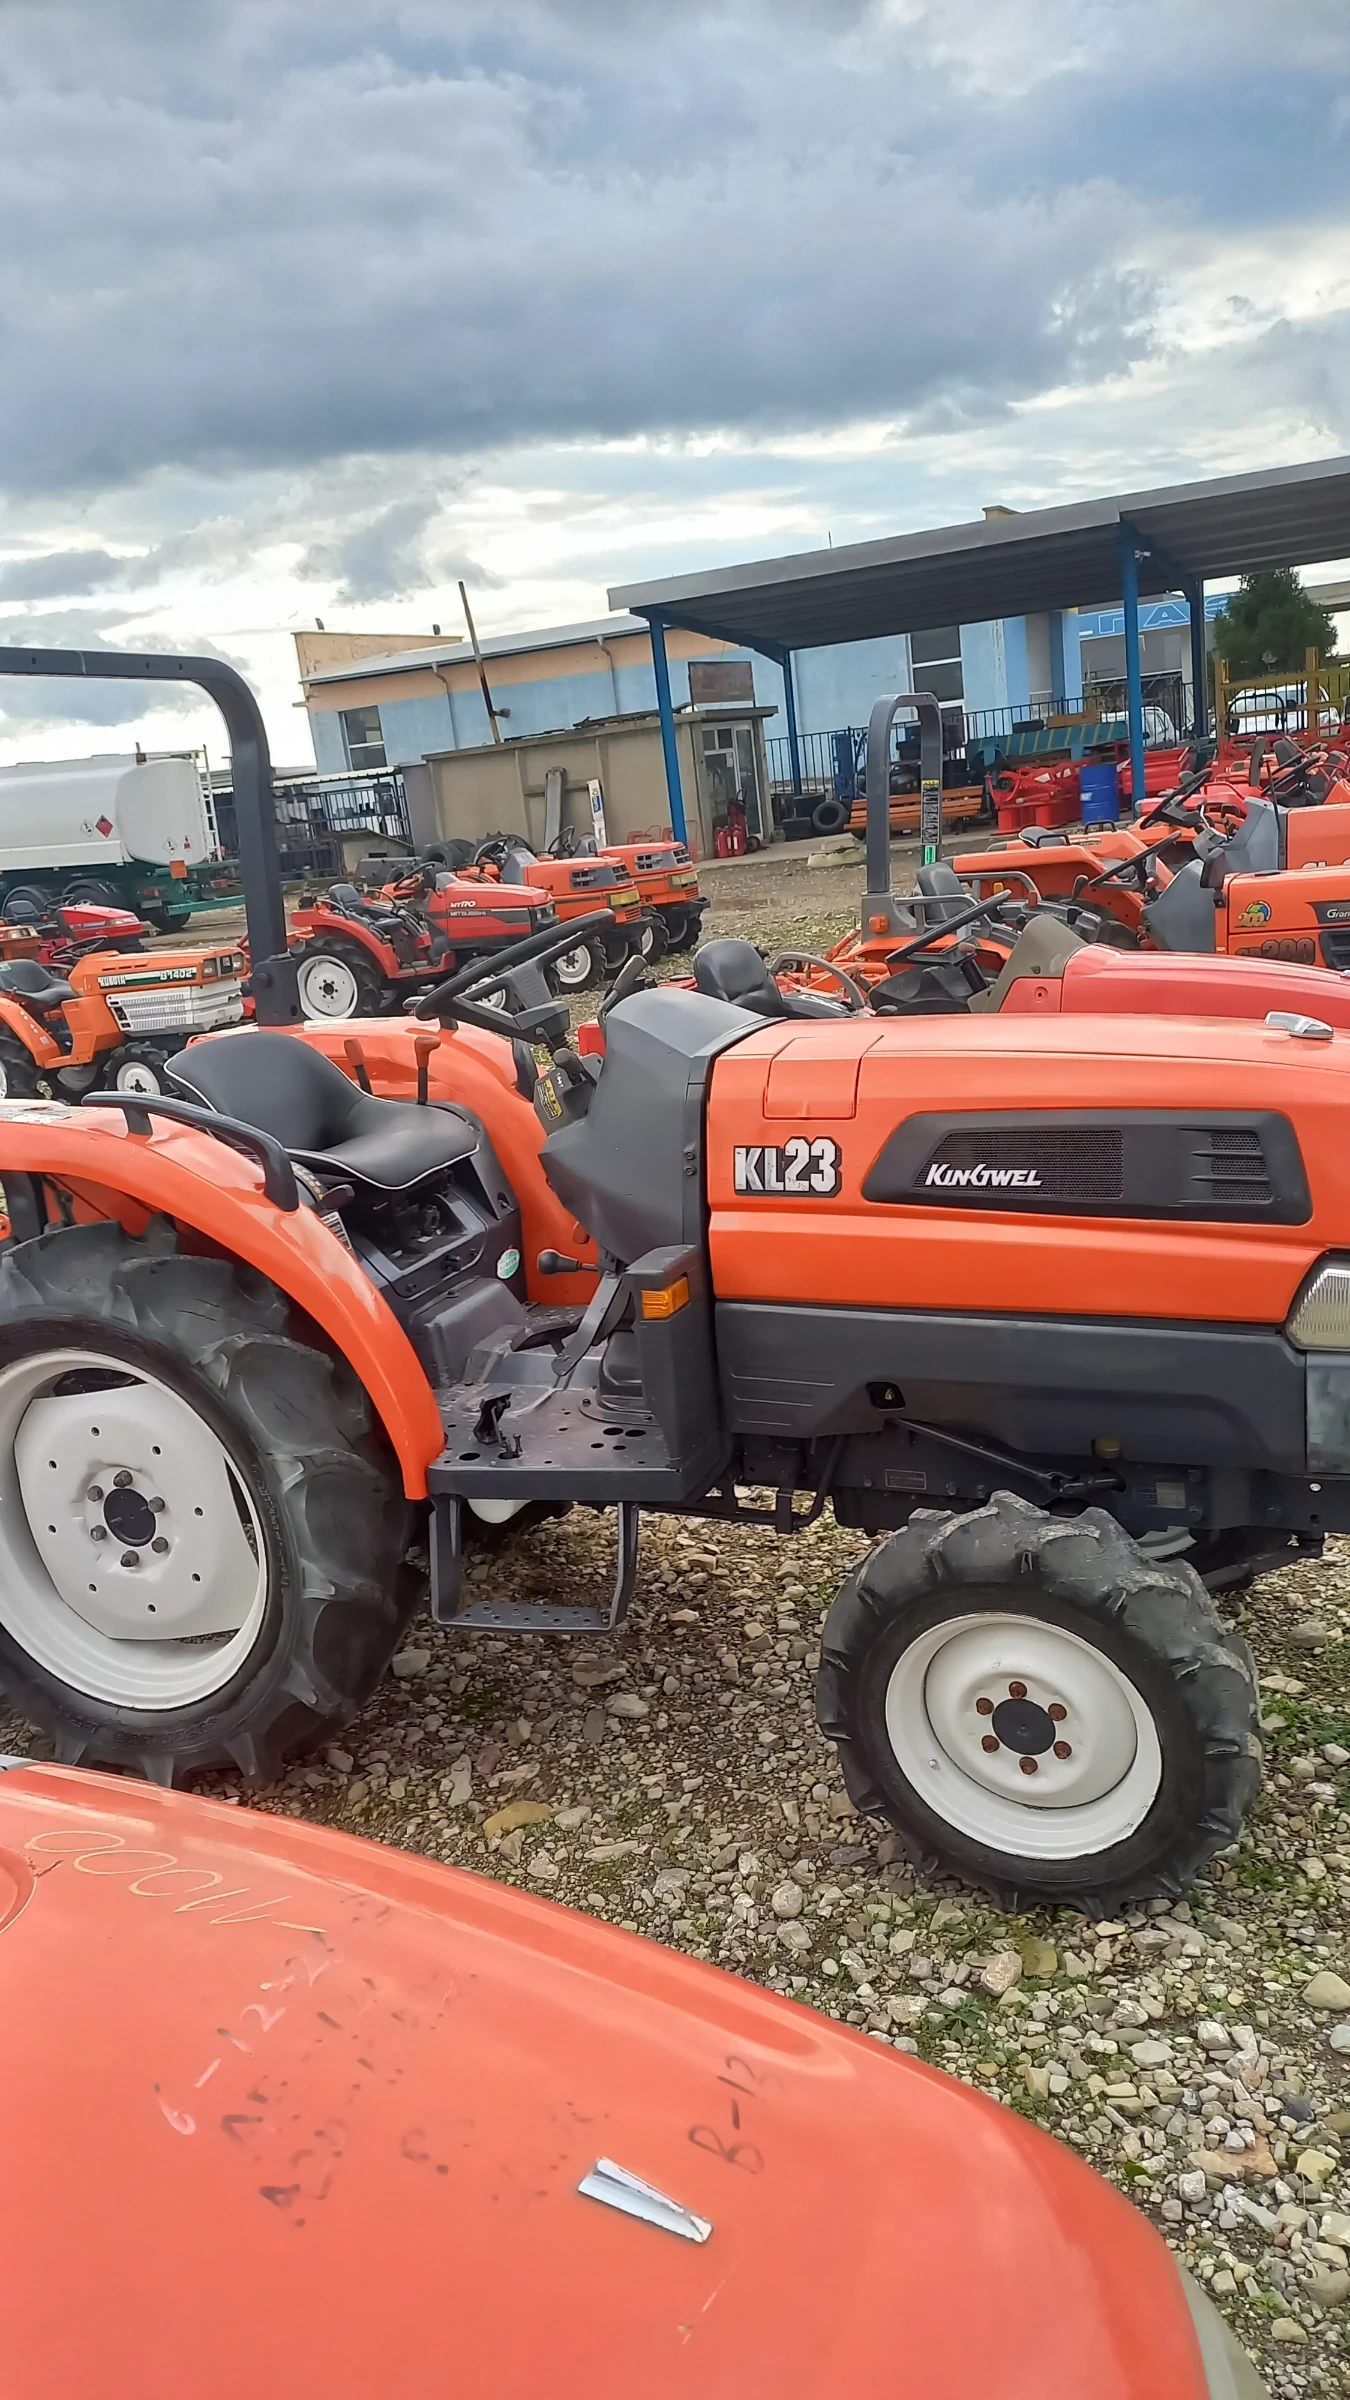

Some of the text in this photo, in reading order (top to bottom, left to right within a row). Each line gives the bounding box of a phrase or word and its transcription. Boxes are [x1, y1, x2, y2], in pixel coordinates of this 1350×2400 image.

[100, 968, 193, 987] KUBOTA B1402
[734, 1137, 839, 1195] KL23
